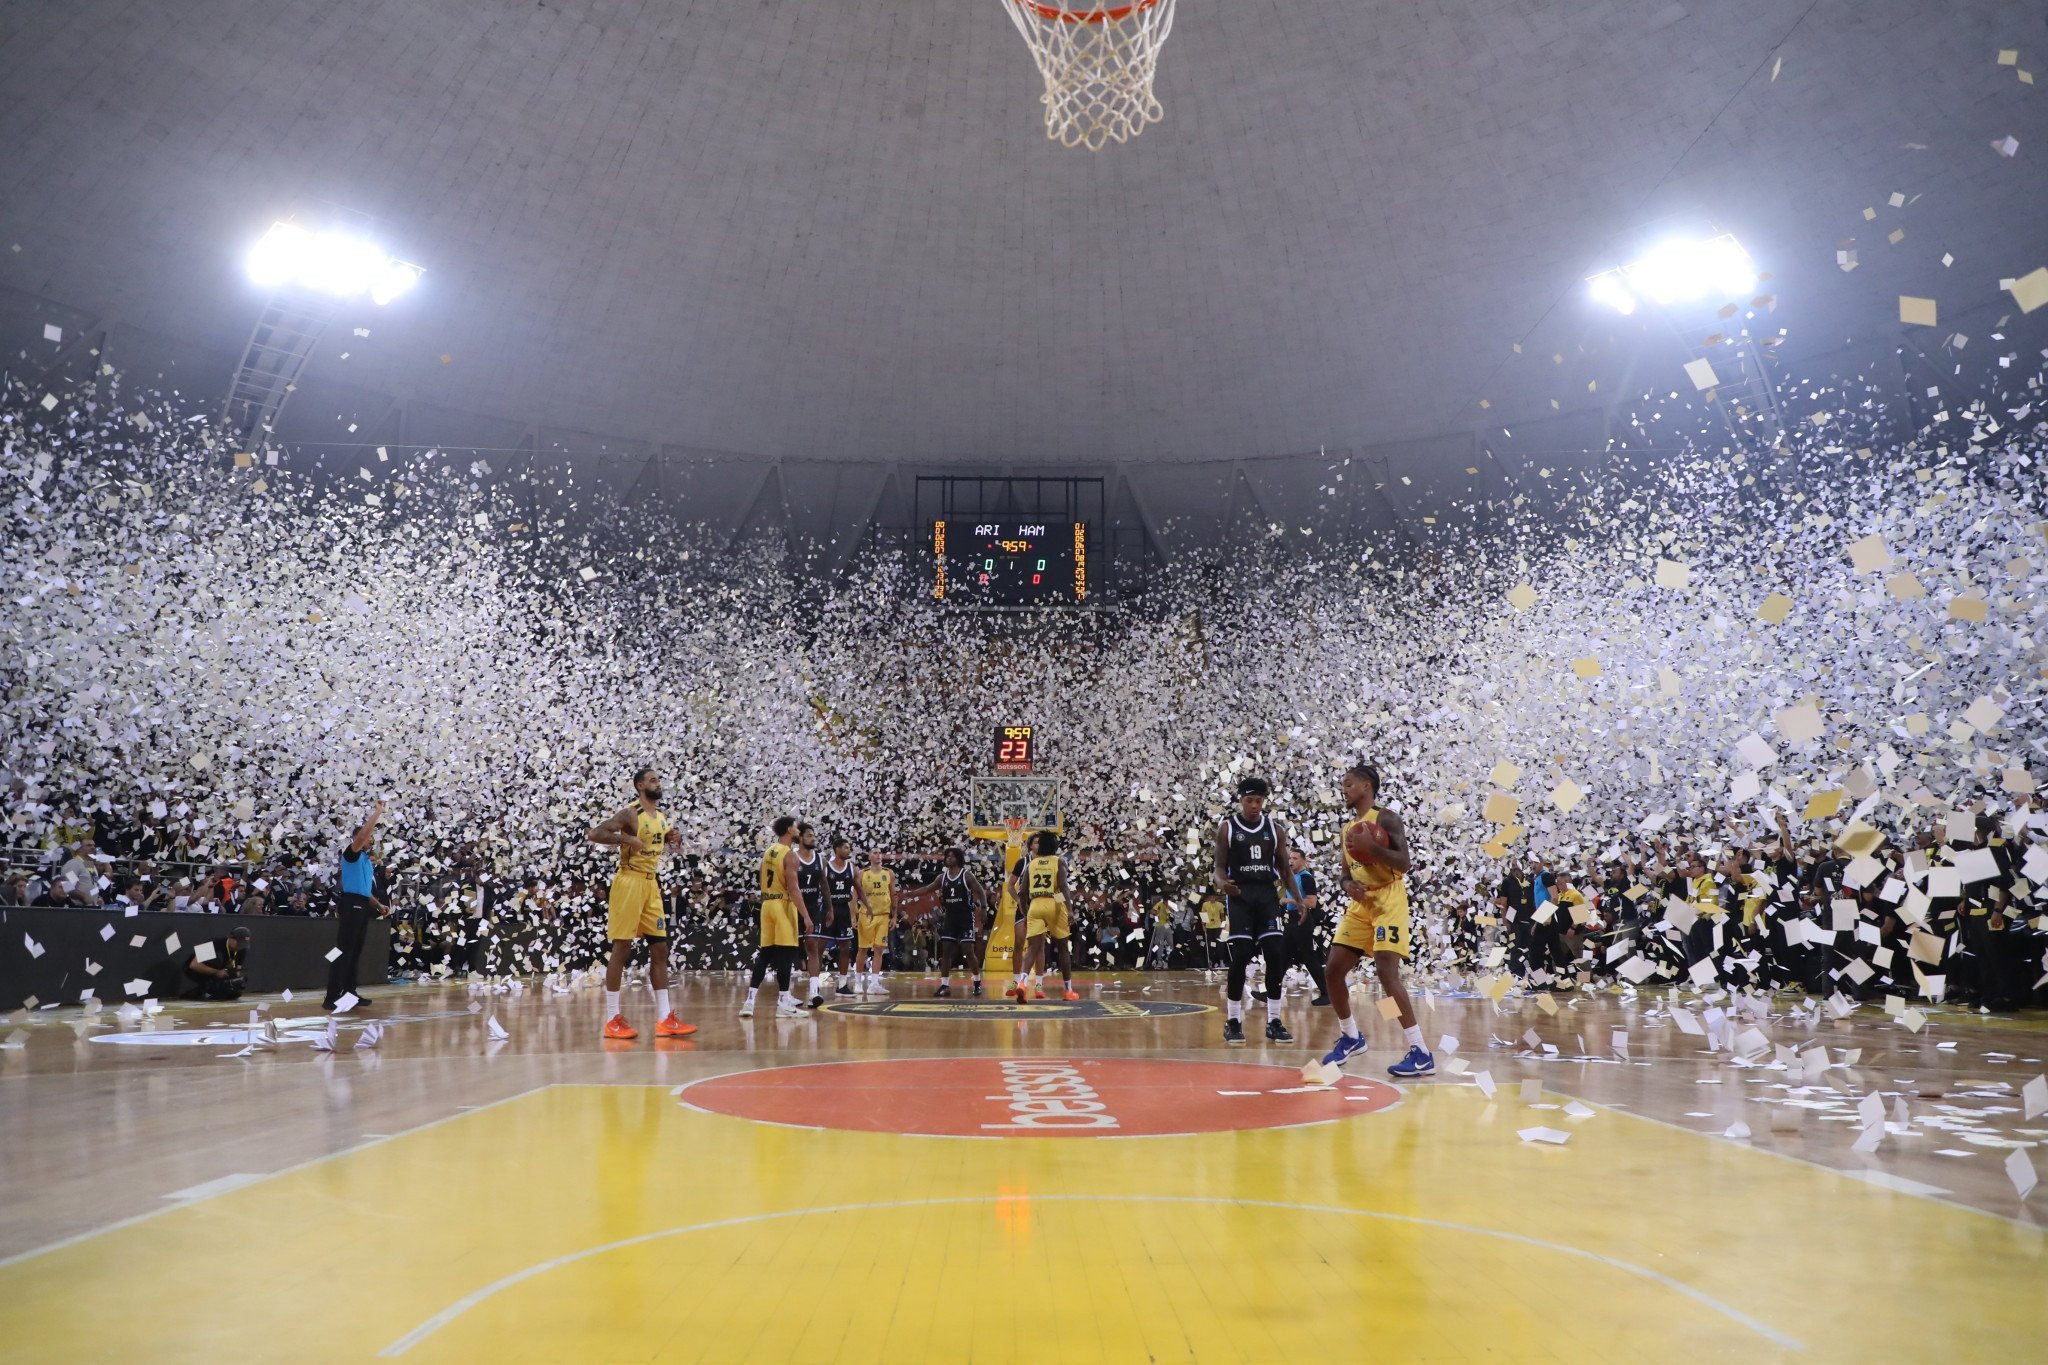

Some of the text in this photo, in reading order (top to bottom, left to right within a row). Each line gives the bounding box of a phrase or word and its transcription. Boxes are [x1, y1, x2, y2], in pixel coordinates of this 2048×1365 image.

[975, 525, 1045, 536] ARI HAM
[1002, 540, 1027, 552] 9:59
[985, 559, 994, 571] 0
[1037, 560, 1046, 571] 0
[1033, 574, 1041, 584] 0
[1005, 727, 1031, 740] 9:59
[1000, 741, 1027, 759] 23
[652, 832, 662, 845] 25
[1249, 845, 1262, 860] 19
[767, 869, 775, 889] 7
[806, 874, 812, 885] 7
[873, 881, 882, 889] 13
[1033, 873, 1052, 889] 23
[950, 887, 955, 897] 2
[1388, 926, 1400, 944] 3
[980, 1060, 1120, 1129] betsson
